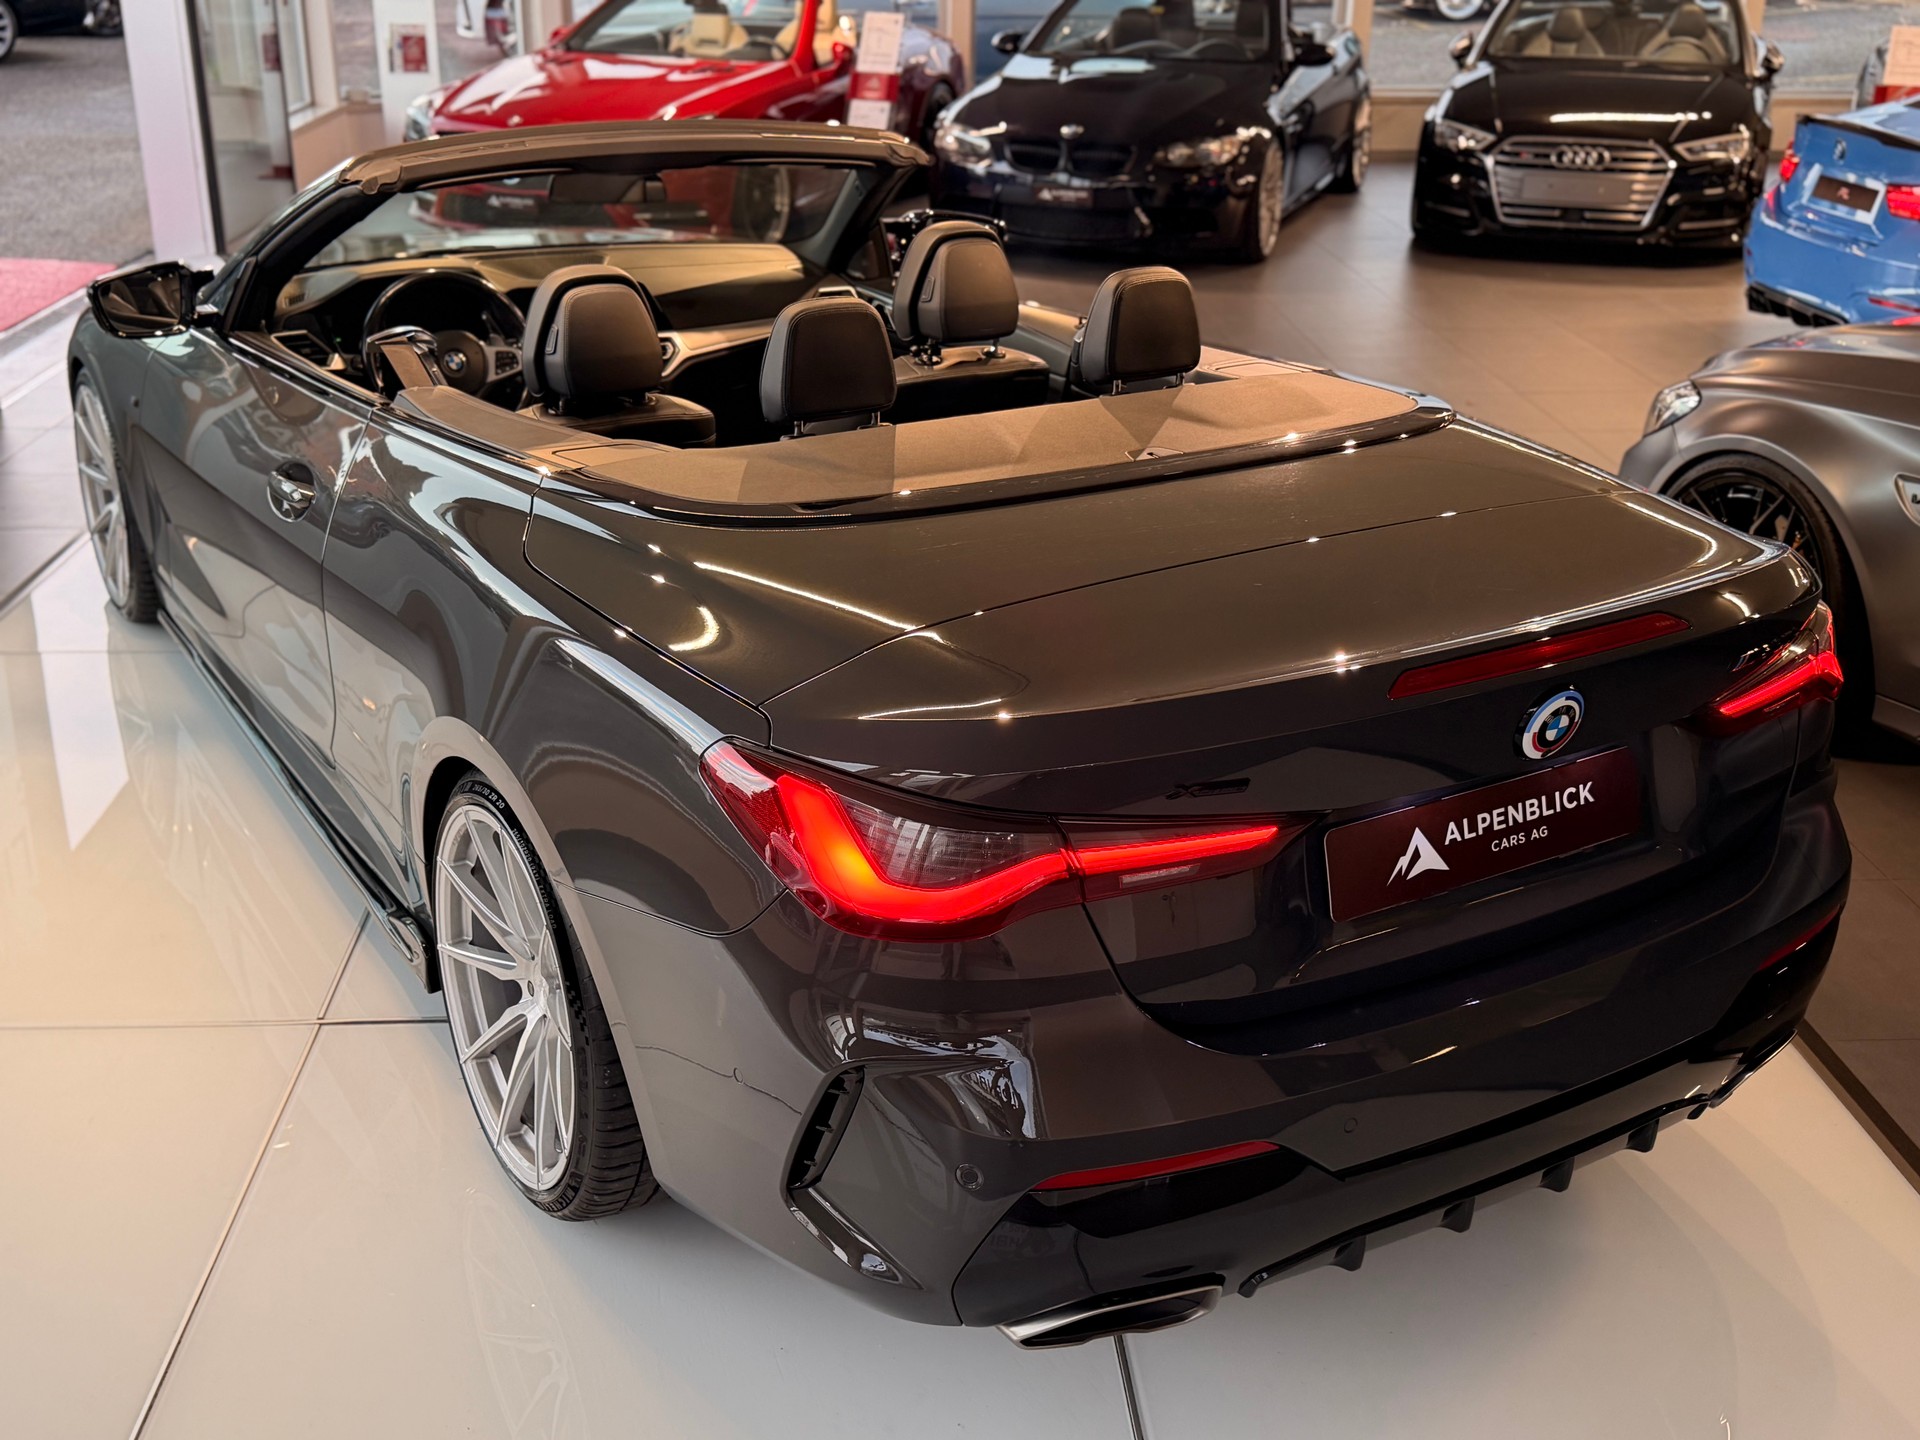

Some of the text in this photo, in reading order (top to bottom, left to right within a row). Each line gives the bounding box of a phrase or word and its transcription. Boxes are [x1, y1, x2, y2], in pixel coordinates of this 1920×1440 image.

[495, 799, 505, 809] 20
[1445, 782, 1595, 845] ALPENBLICK
[1491, 826, 1549, 852] CARS AG
